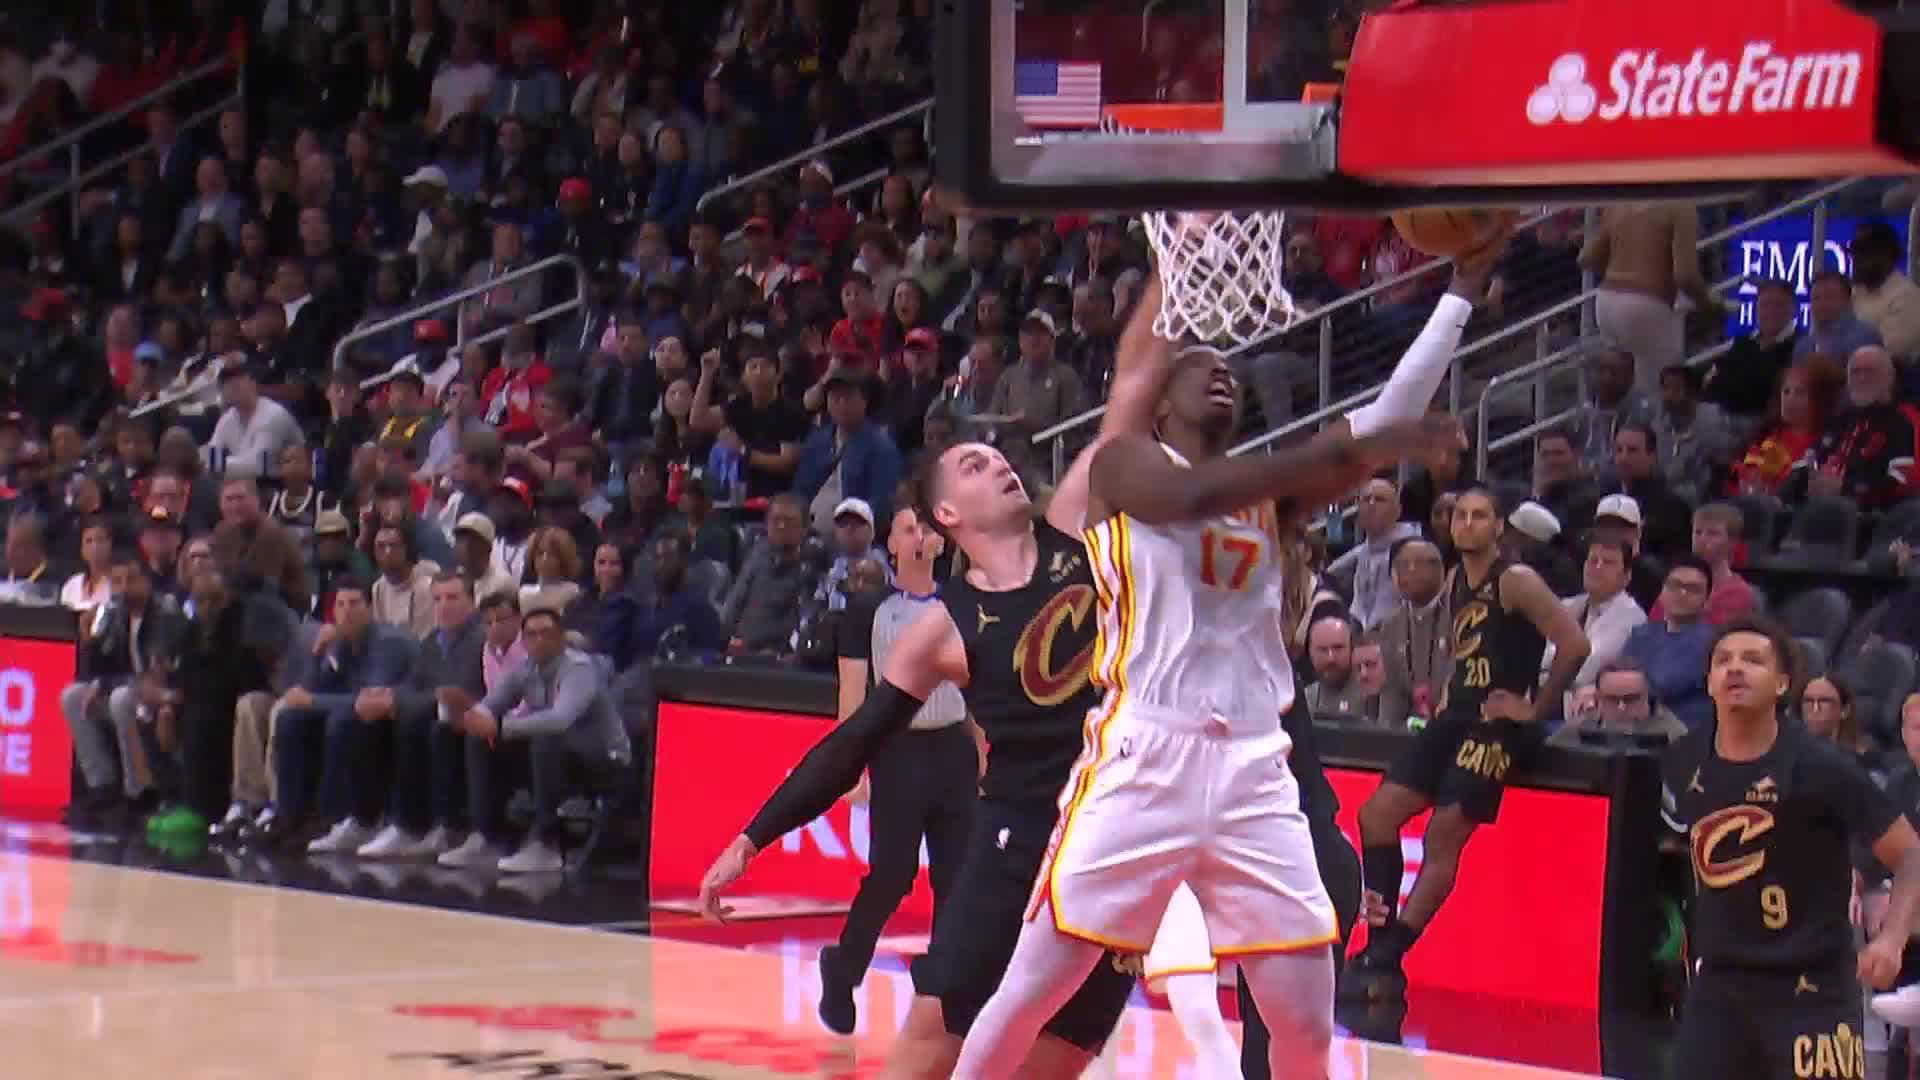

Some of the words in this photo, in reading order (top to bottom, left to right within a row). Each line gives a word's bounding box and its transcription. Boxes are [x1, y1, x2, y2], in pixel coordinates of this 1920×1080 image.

[1200, 528, 1264, 592] 17
[1464, 657, 1491, 688] 20
[1760, 884, 1789, 930] 9
